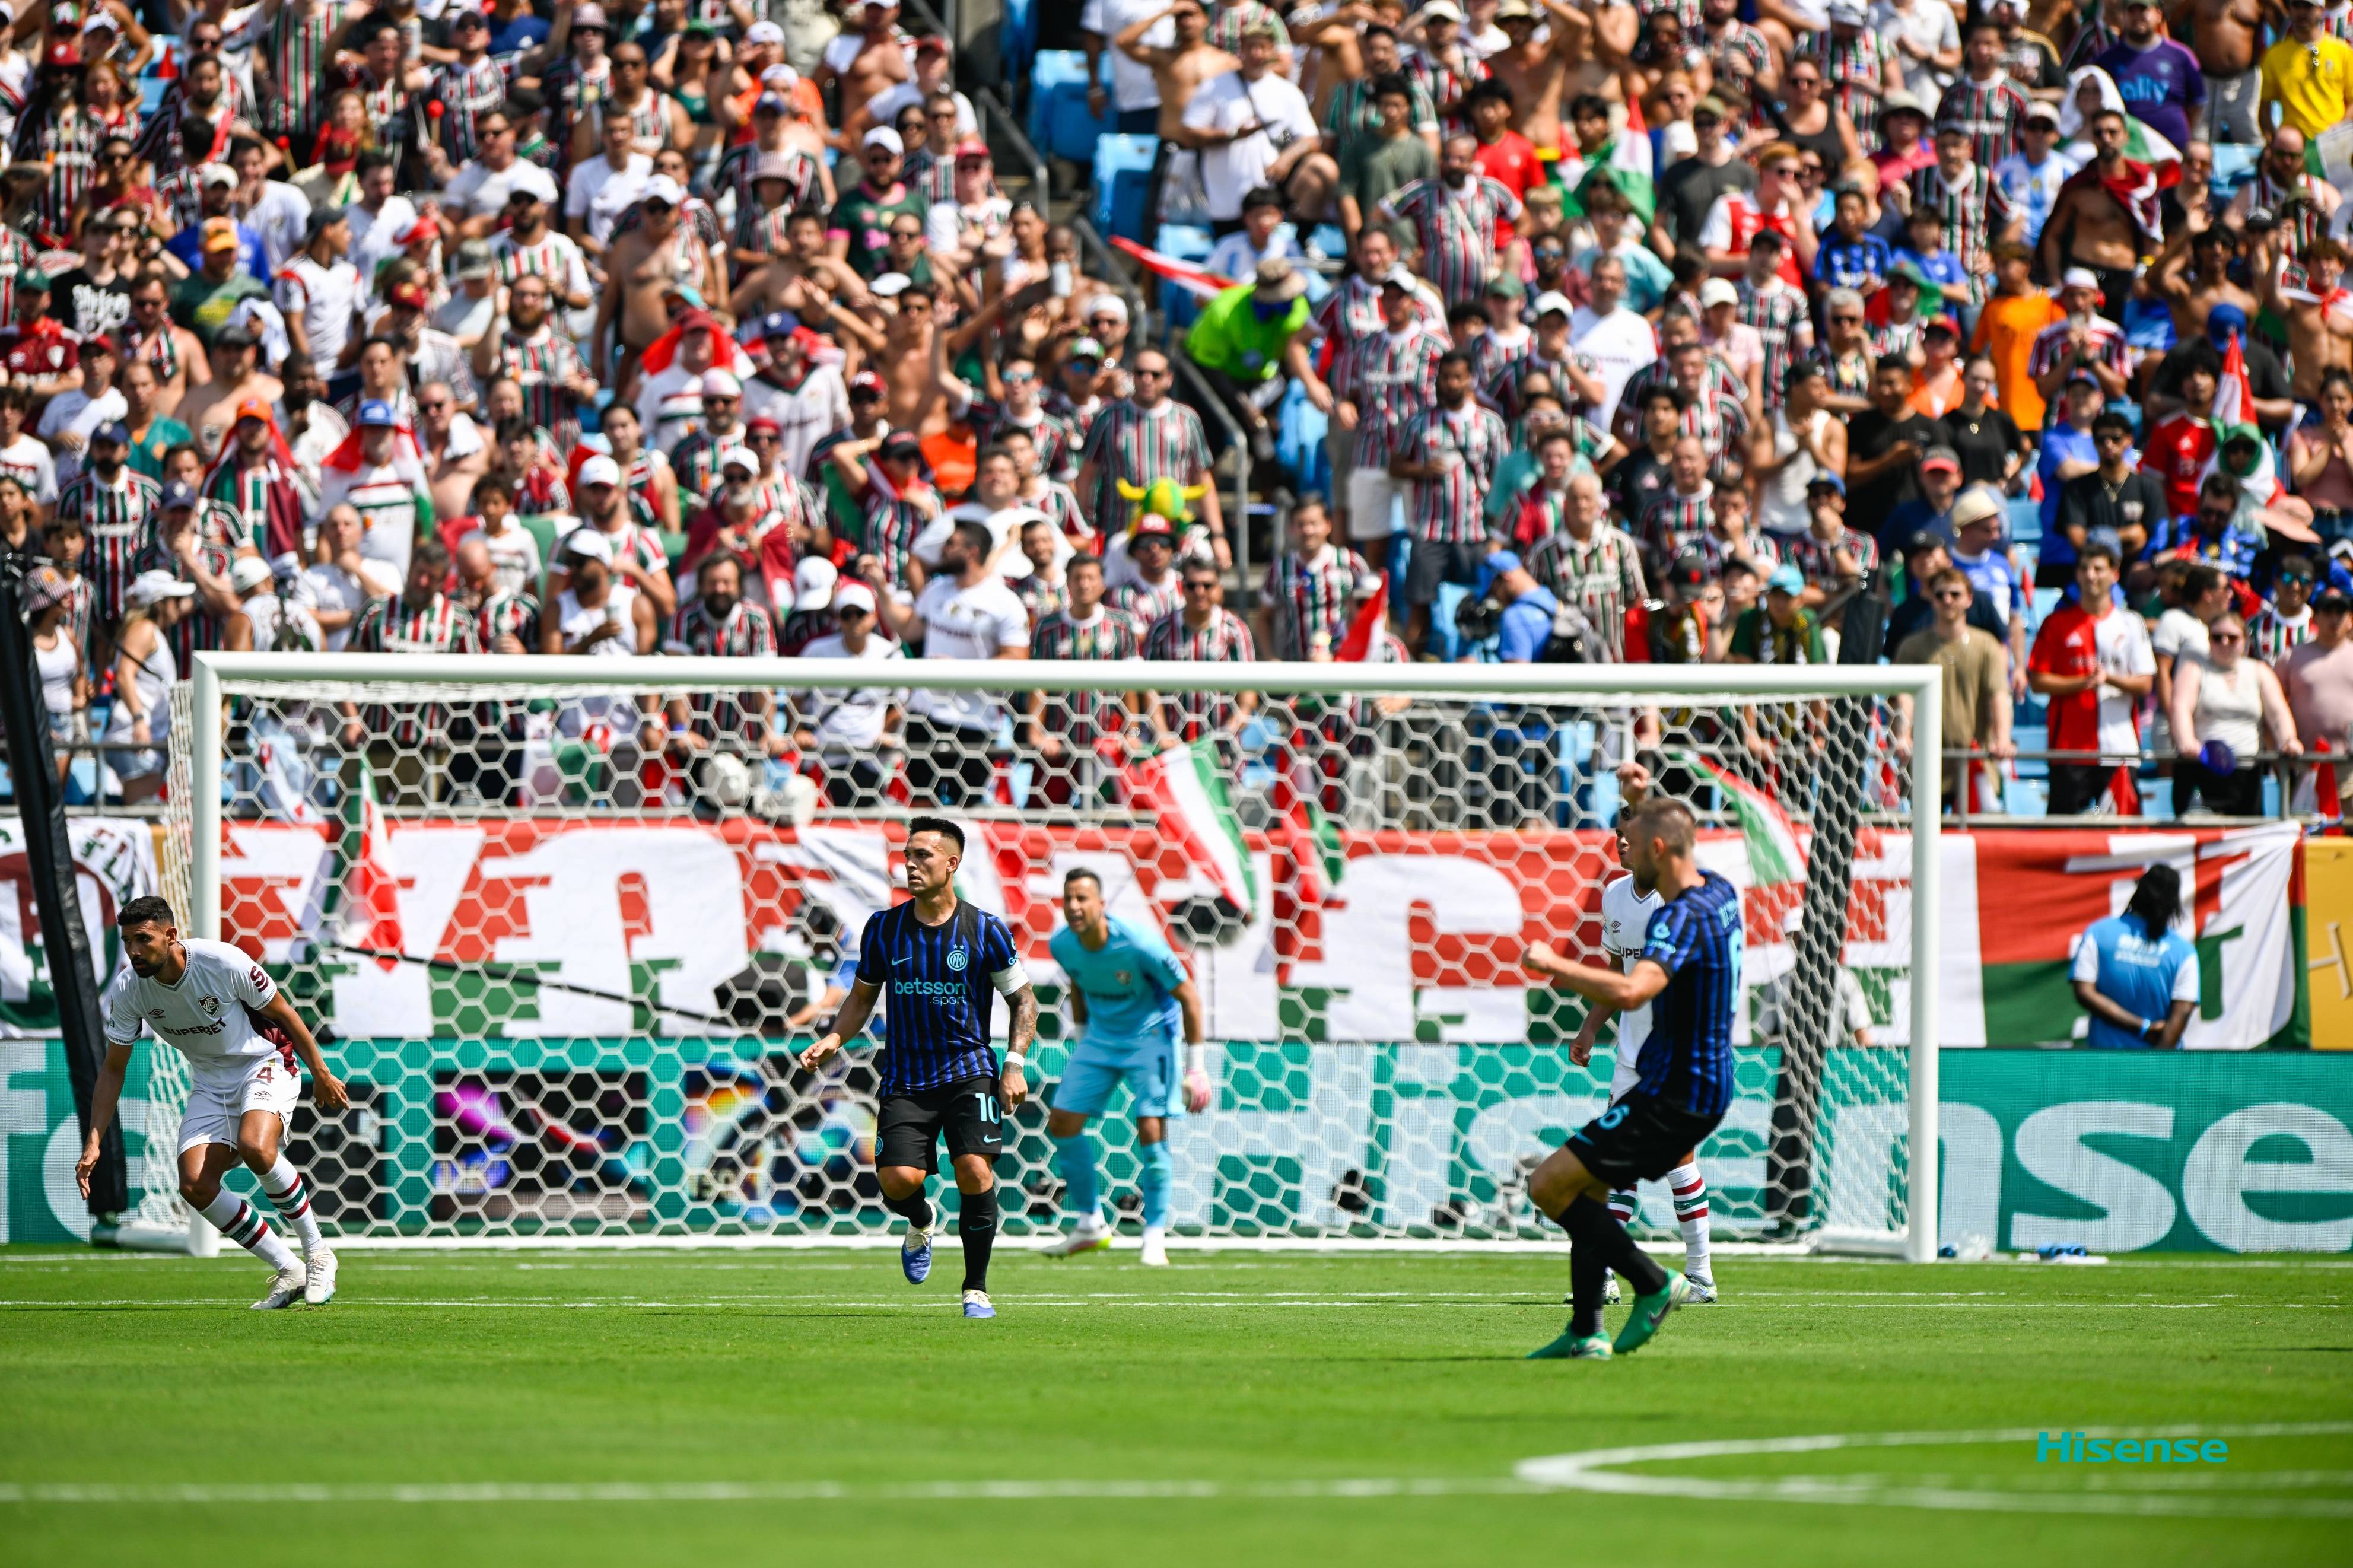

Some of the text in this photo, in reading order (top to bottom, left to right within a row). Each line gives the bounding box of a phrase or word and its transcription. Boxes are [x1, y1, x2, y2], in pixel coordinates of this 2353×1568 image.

[2119, 74, 2170, 106] ally
[895, 977, 966, 995] betsson
[163, 1017, 227, 1036] SUPERBET
[256, 1066, 275, 1084] 4
[975, 1092, 1000, 1125] 10
[1597, 1103, 1630, 1130] 6
